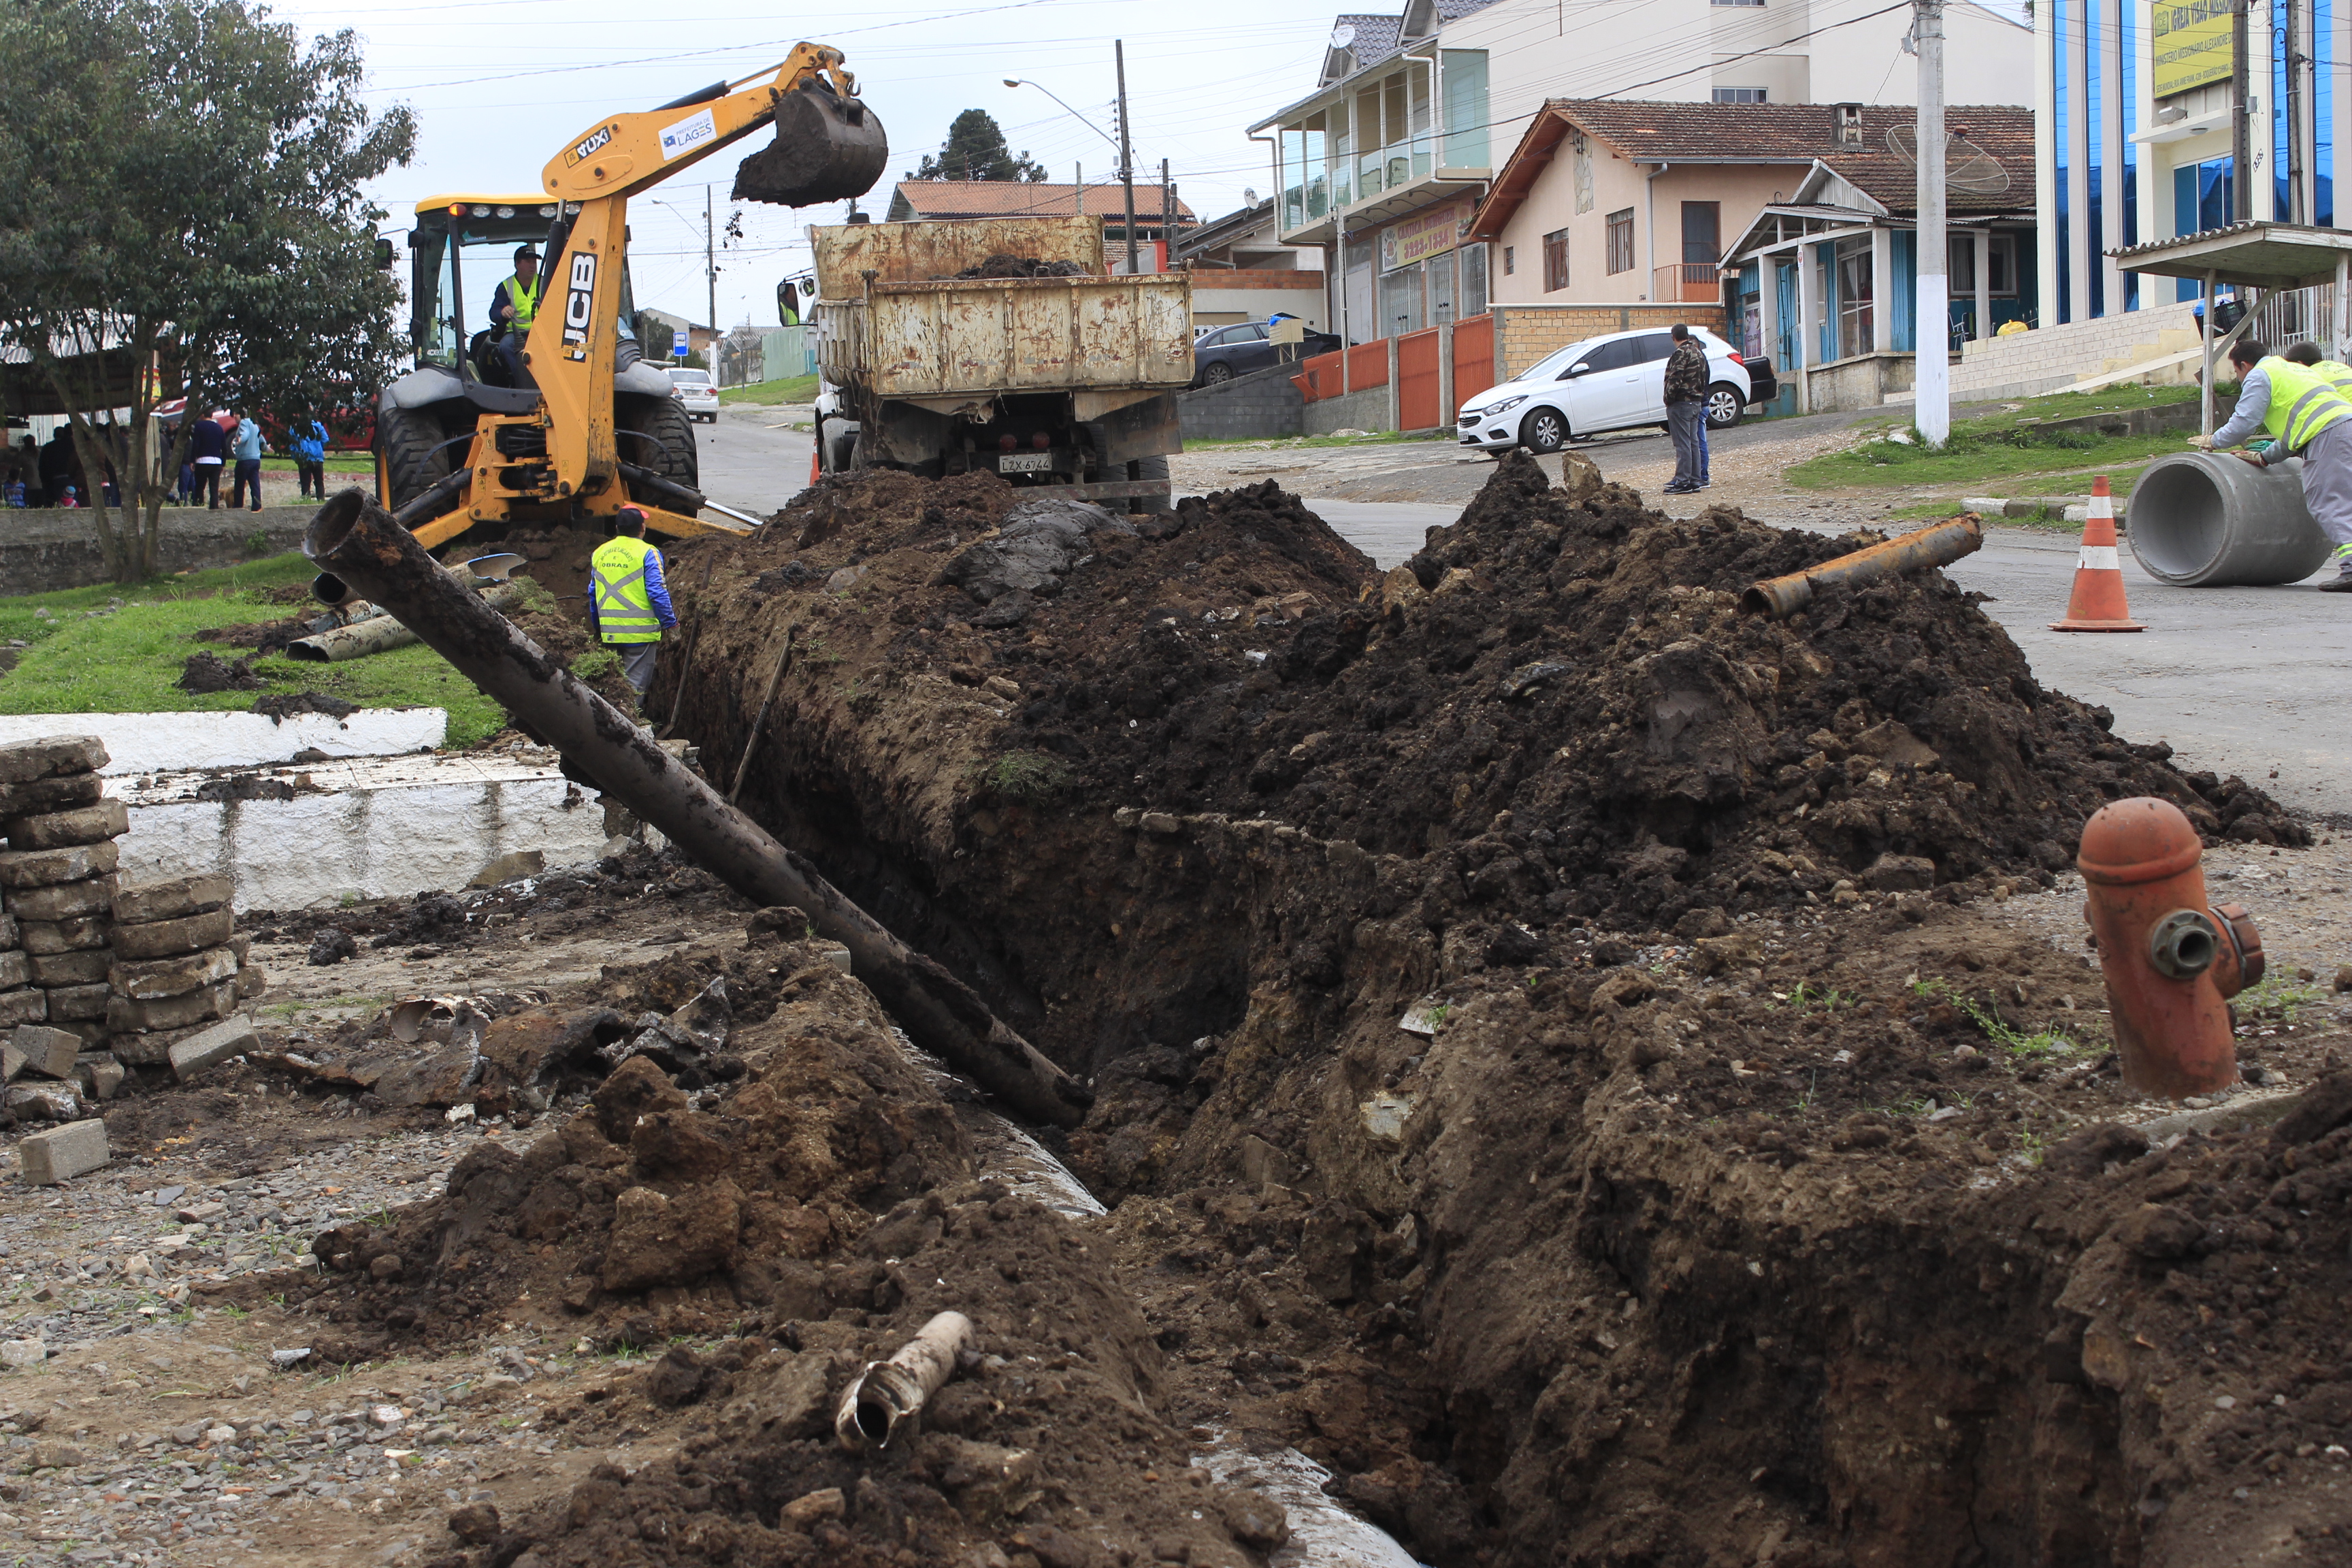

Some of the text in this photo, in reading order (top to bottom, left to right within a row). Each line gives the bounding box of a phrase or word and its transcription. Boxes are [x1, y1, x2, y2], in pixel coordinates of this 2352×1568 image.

[2157, 17, 2166, 28] IDE
[2171, 5, 2189, 32] IGREJA
[2209, 0, 2233, 20] MISSION
[2155, 50, 2177, 67] MINISTÉRIO
[2178, 41, 2204, 60] MISSIONÁRIO
[2204, 33, 2227, 51] ALEXANDRE
[676, 120, 703, 136] PREFEITURA
[677, 123, 712, 146] LAGES
[576, 129, 607, 157] 4CX
[1403, 228, 1449, 259] 3223-1334
[564, 255, 595, 360] JCB
